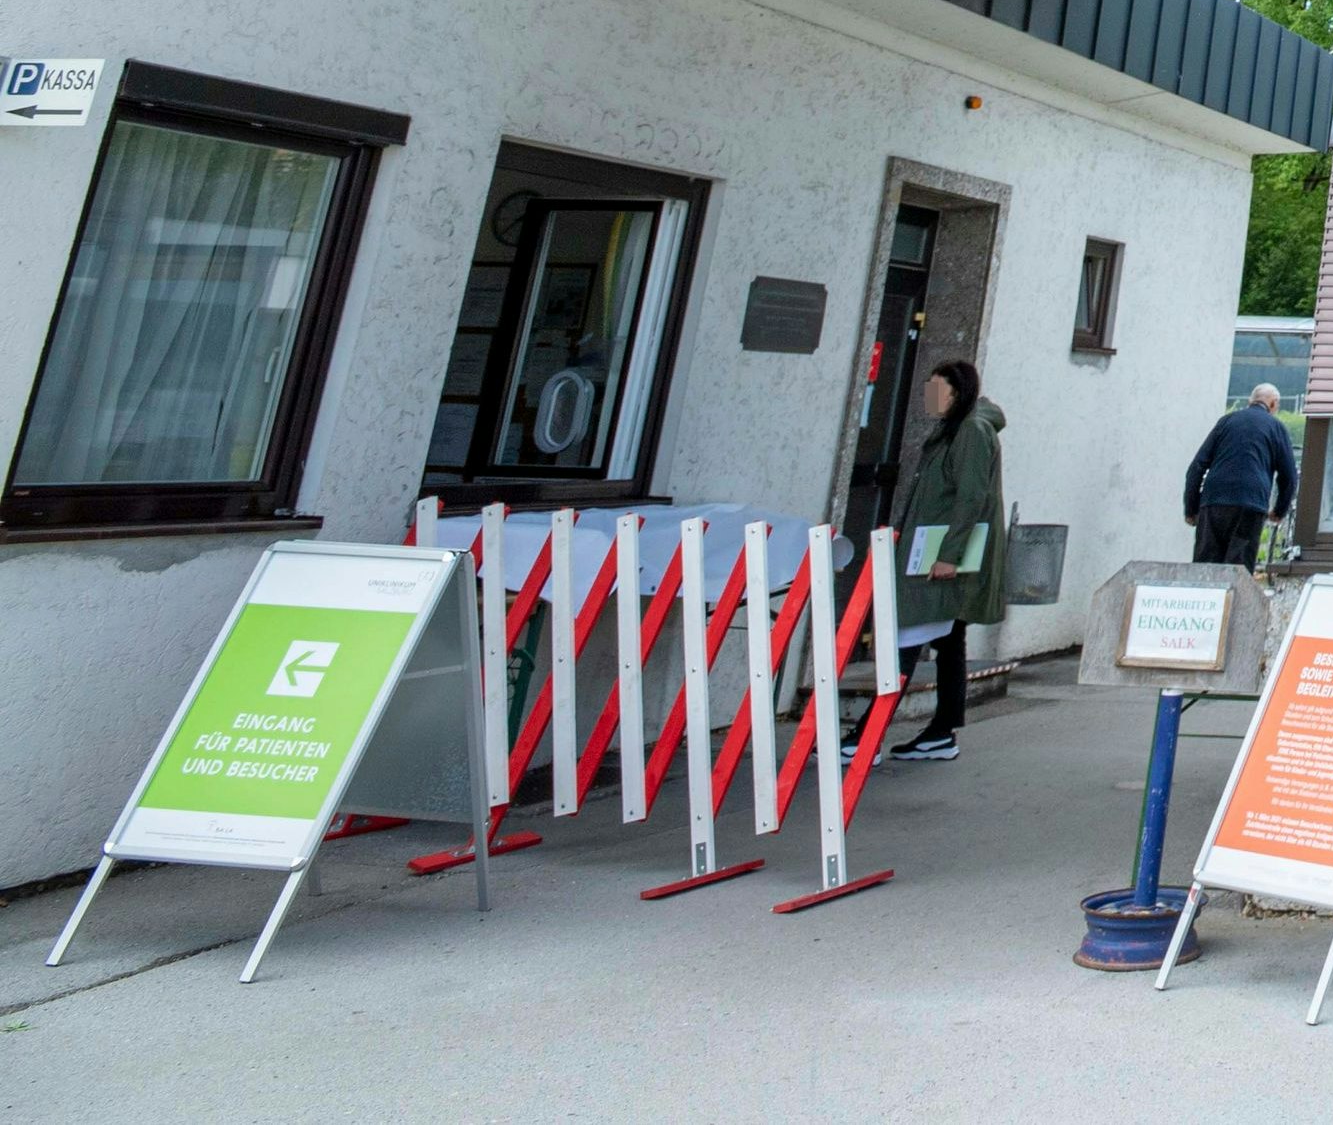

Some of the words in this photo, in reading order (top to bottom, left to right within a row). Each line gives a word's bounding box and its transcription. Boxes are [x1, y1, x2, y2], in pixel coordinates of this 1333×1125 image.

[40, 69, 96, 91] KASSA
[1140, 598, 1217, 611] MITARBEITER
[1136, 615, 1215, 632] EINGANG
[1160, 636, 1197, 649] SALK
[1299, 666, 1333, 682] SOWIE
[232, 712, 317, 734] EINGANG
[193, 730, 233, 752] FÜR
[233, 736, 332, 759] PATIENTEN
[181, 756, 225, 776] UND
[225, 759, 320, 783] BESUCHER
